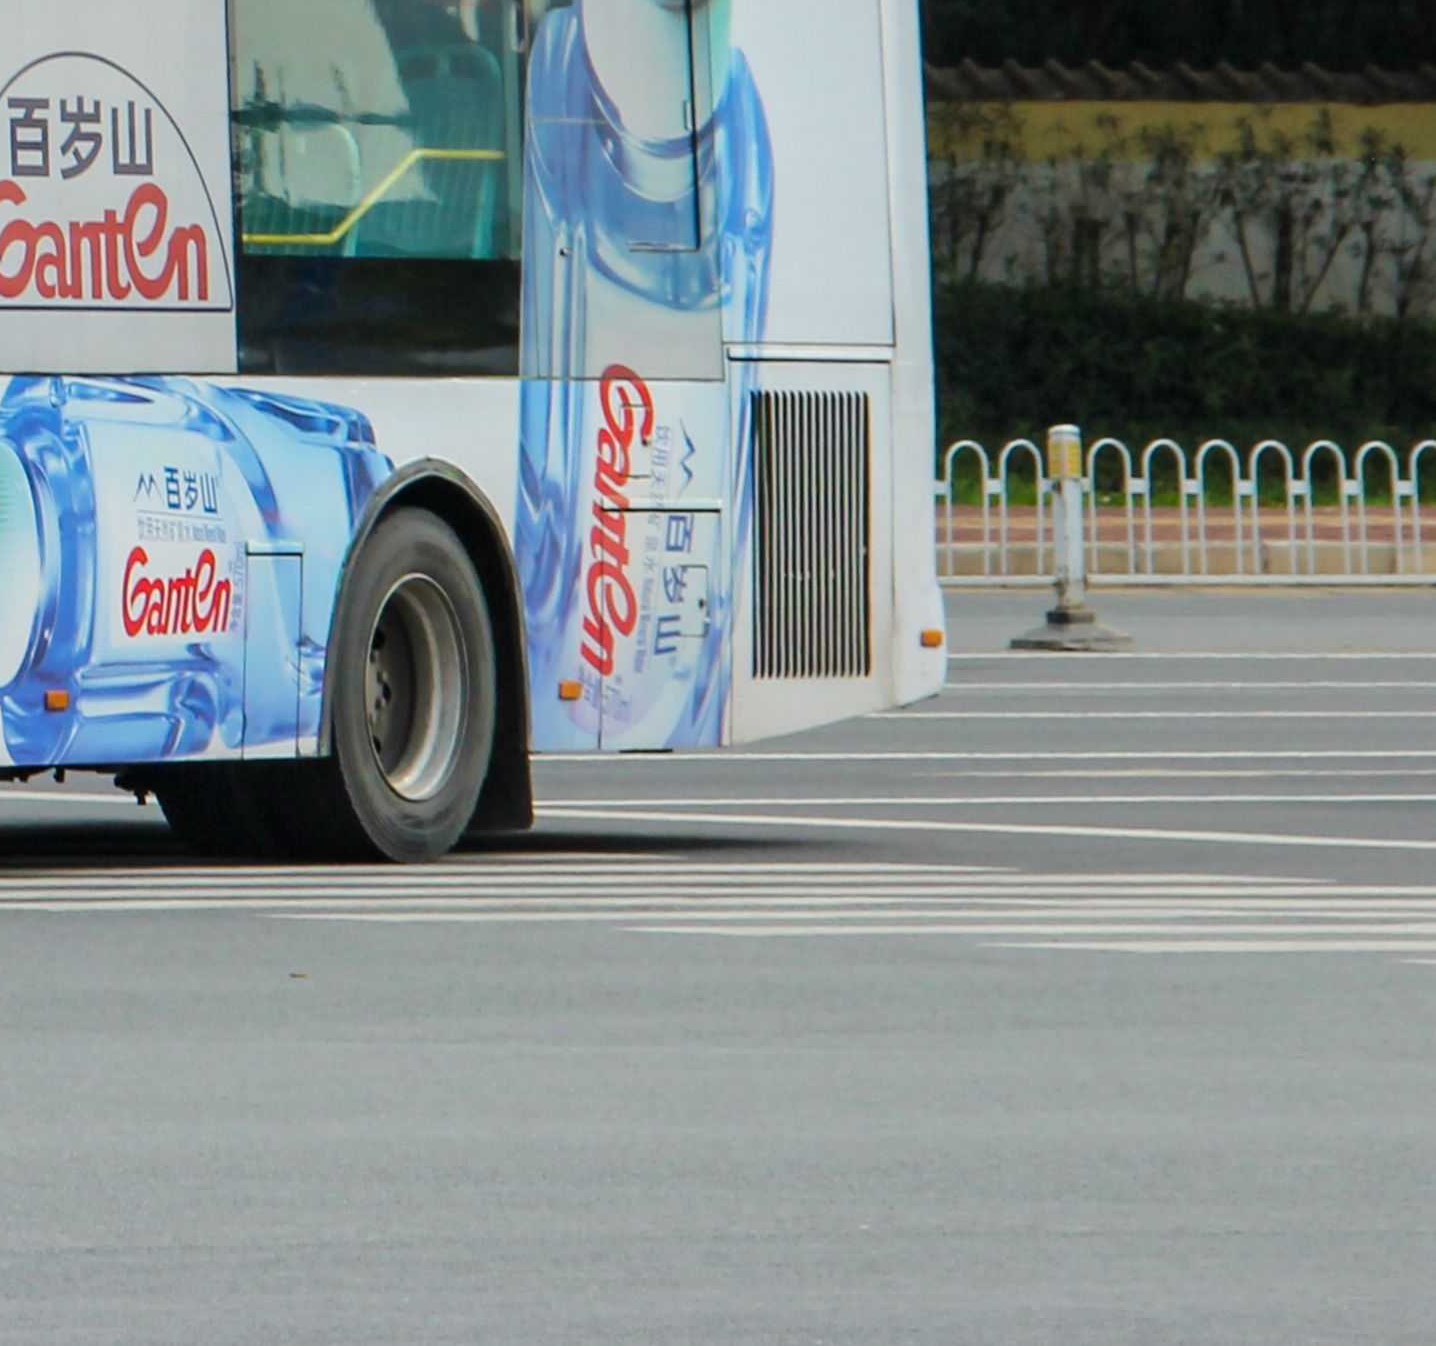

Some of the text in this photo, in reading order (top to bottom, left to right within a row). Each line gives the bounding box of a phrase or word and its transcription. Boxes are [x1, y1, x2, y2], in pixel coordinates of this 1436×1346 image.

[7, 95, 153, 179] 百岁山
[164, 466, 217, 513] 百岁山
[580, 365, 654, 676] Ganten
[122, 546, 231, 637] Ganten
[654, 514, 694, 656] 百岁山
